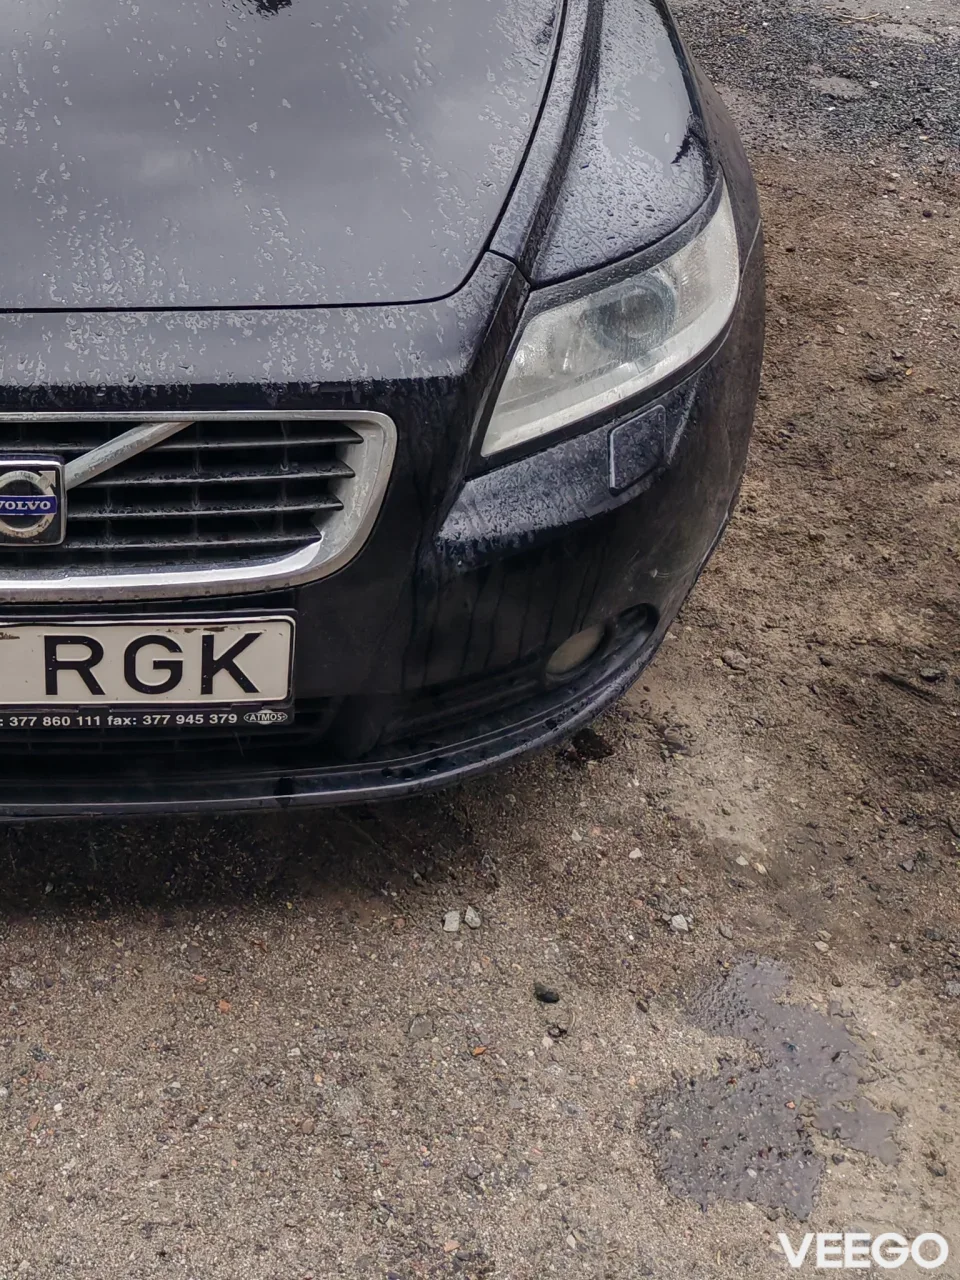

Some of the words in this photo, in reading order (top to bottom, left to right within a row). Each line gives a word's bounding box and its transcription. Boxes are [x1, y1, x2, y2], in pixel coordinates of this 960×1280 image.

[44, 633, 262, 696] RGK
[9, 716, 37, 726] 377
[42, 716, 71, 726] 860
[76, 716, 101, 726] 111
[107, 714, 137, 726] fax:
[142, 715, 171, 725] 377
[175, 714, 204, 725] 945
[209, 713, 238, 724] 379
[248, 713, 283, 722] ATMOS
